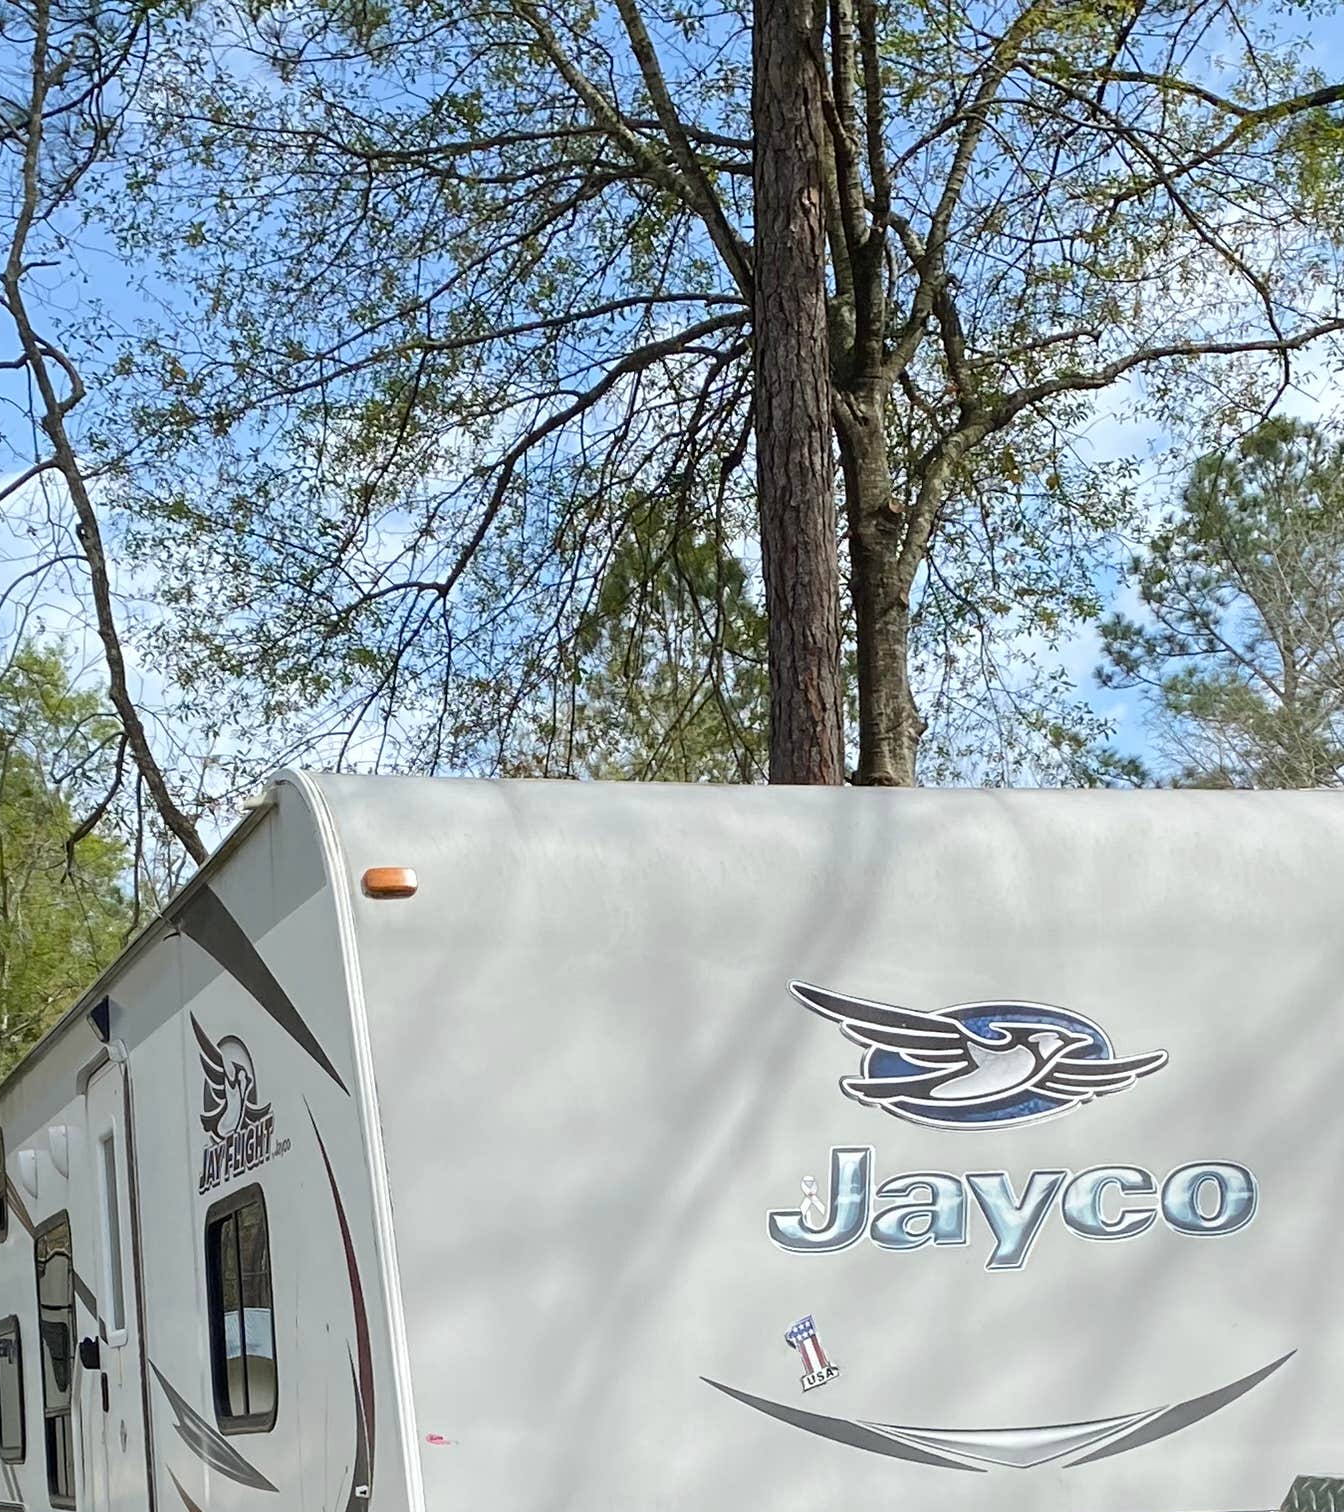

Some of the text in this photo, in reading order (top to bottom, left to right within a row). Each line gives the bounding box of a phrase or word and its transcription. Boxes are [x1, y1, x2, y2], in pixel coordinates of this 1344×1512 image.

[199, 1143, 226, 1195] JAY
[224, 1113, 274, 1182] FLIGHT
[768, 1145, 1258, 1271] Jayco
[807, 1367, 834, 1385] USA
